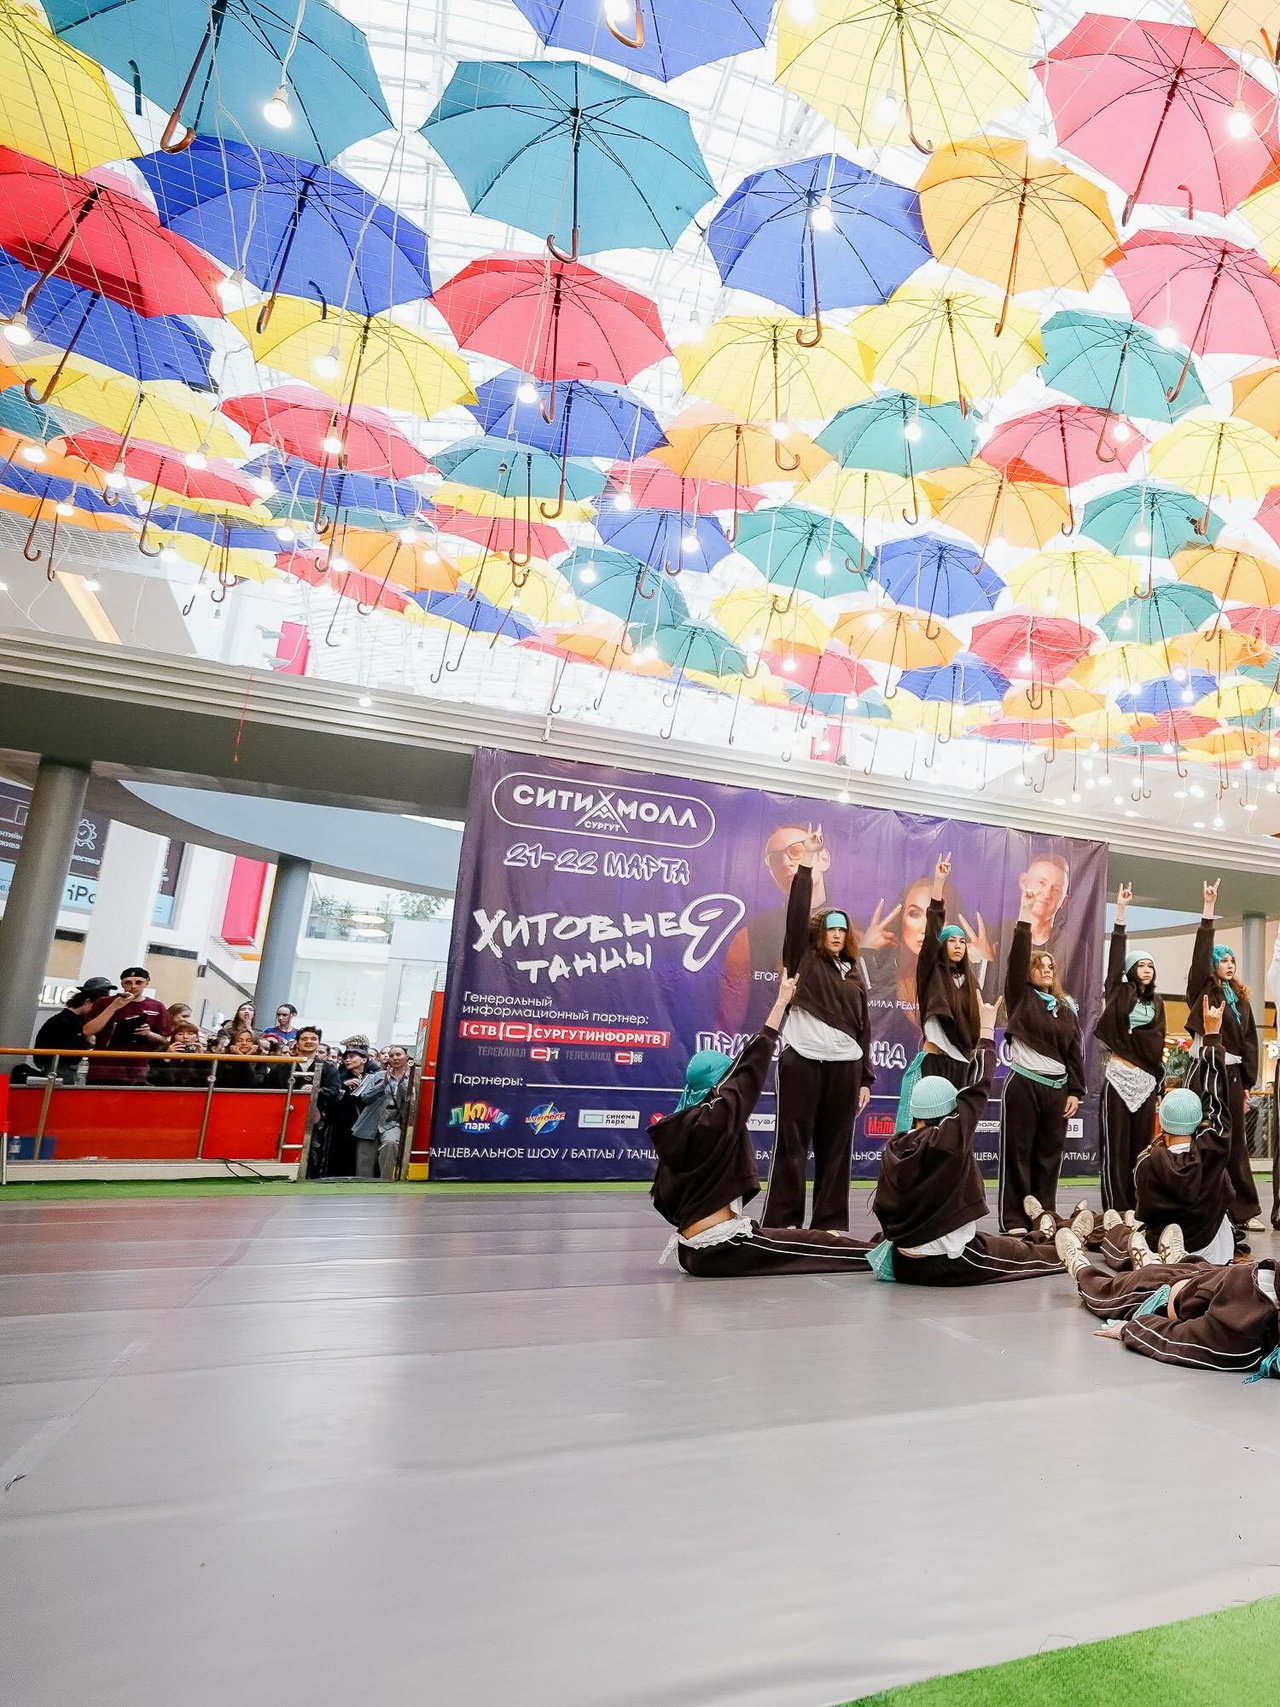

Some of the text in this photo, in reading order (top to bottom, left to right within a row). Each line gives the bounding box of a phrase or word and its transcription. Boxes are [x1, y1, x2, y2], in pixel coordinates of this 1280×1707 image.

[584, 820, 621, 833] СУРГУТ
[504, 842, 691, 886] 21-22 МАРТА
[472, 908, 682, 959] ХИТОВЫЕ
[516, 941, 653, 984] ТАНЦЫ
[753, 971, 780, 982] ЕГОР
[463, 991, 553, 1007] Генеральный
[866, 999, 919, 1012] МИЛА РЕДИ
[462, 1004, 650, 1025] информационный партнер:
[477, 1045, 527, 1059] ТЕЛЕКАНАЛ
[565, 1049, 611, 1062] ТЕЛЕКАНАЛ
[452, 1073, 524, 1088] Партнеры:
[448, 1101, 511, 1127] ЛЮМИ
[464, 1121, 491, 1132] парк
[527, 1148, 559, 1160] ШОУ
[571, 1148, 615, 1160] БАТТЛЫ
[626, 1148, 660, 1161] ТАНЦ
[1063, 1152, 1090, 1161] АТТЛЫ
